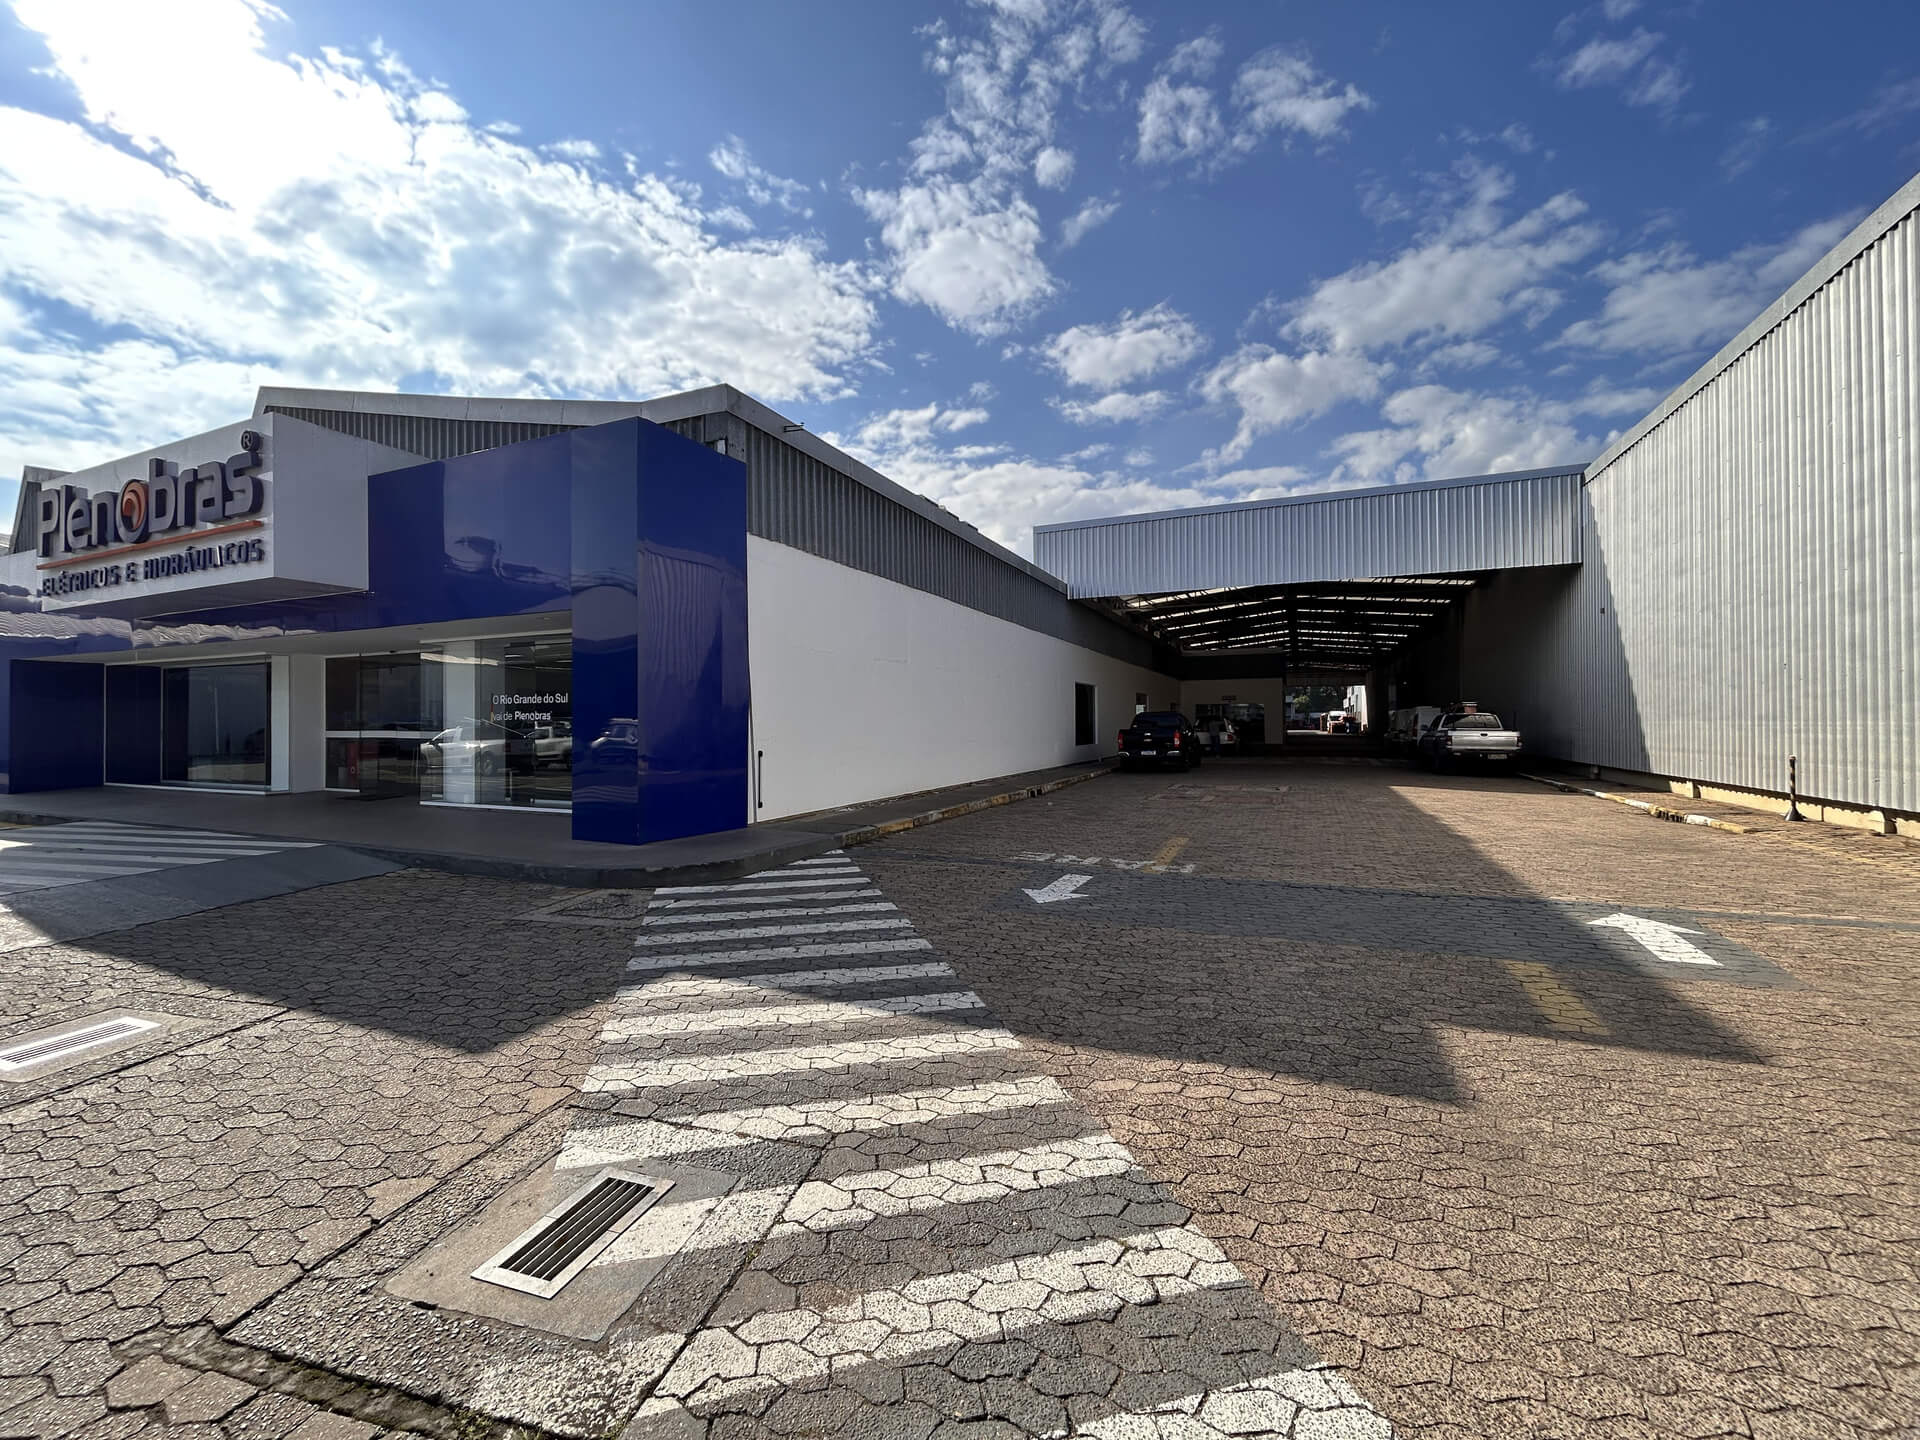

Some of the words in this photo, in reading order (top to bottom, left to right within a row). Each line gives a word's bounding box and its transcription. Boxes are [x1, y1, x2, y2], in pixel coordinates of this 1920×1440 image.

[42, 568, 121, 597] ELÉTRICOS
[126, 561, 137, 582] E
[143, 538, 265, 580] HIDRÁULICOS
[493, 695, 499, 705] O
[500, 694, 513, 705] Rio
[513, 693, 542, 704] Grande
[543, 693, 554, 704] do
[555, 692, 569, 704] Sul
[503, 711, 513, 721] de
